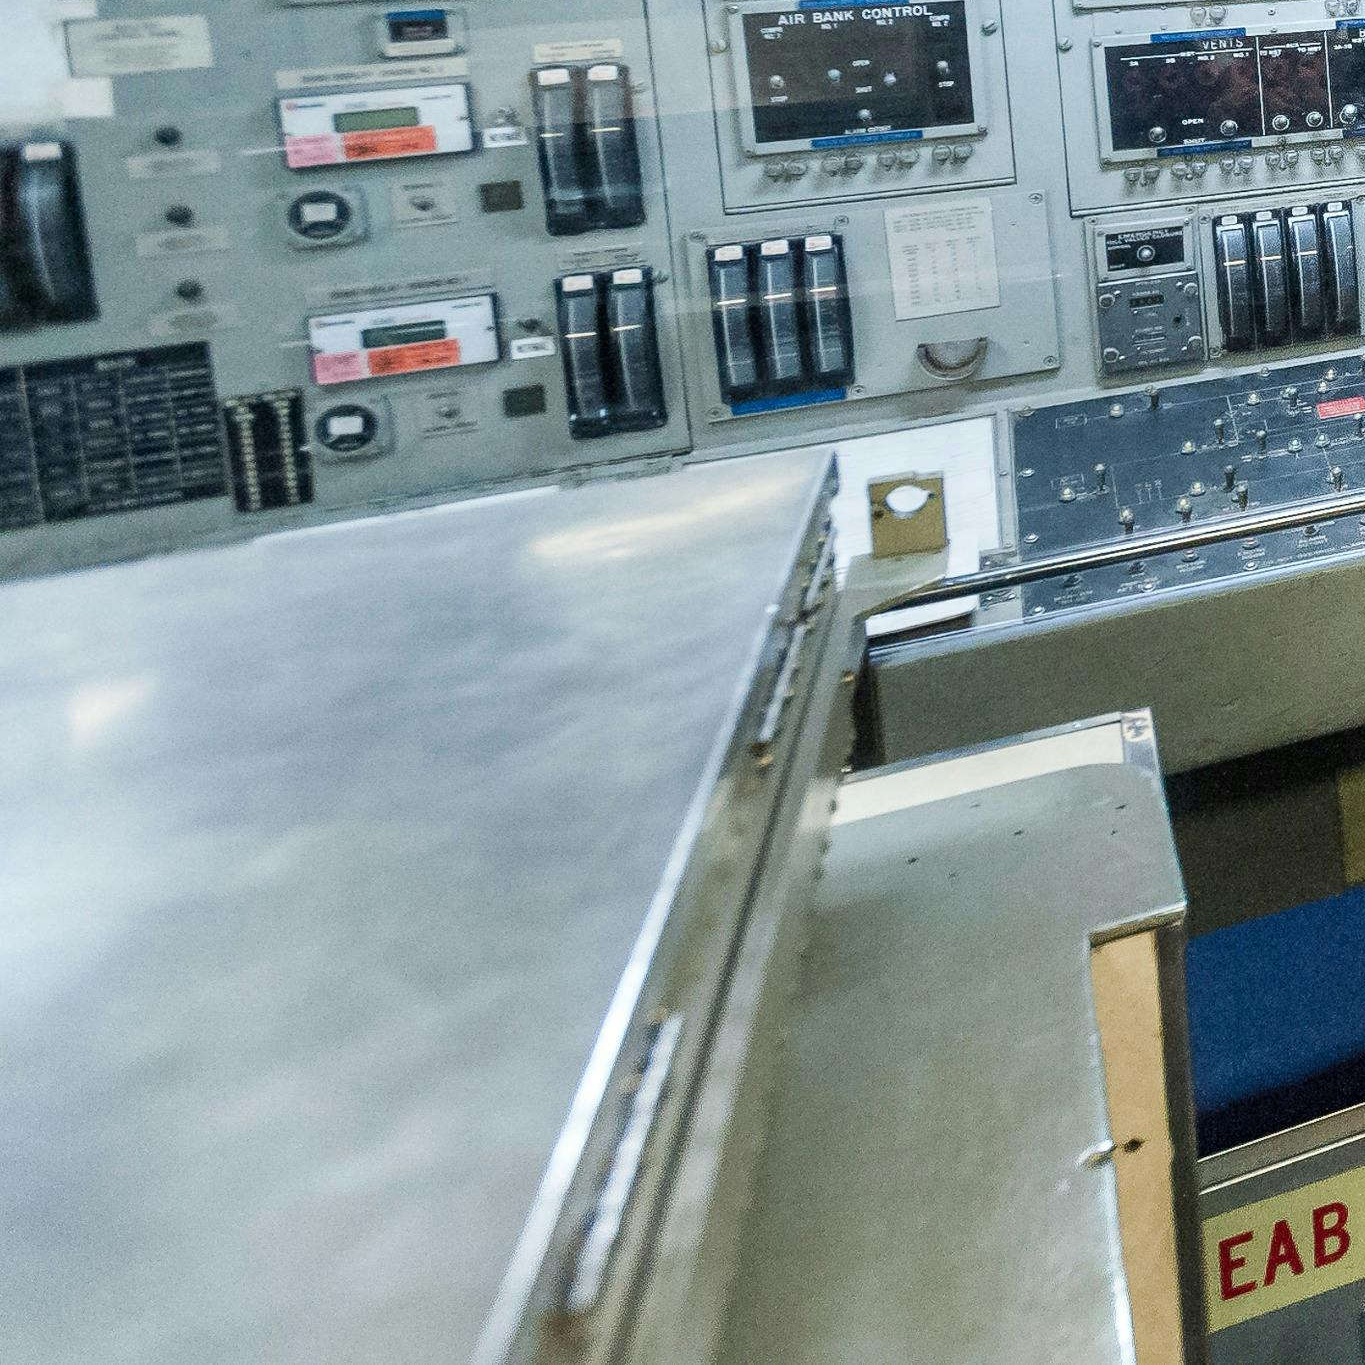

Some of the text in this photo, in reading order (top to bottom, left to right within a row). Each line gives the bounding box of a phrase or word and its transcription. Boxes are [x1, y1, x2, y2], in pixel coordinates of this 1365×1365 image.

[777, 5, 934, 26] AIR BANK CONTROL
[1202, 38, 1244, 51] VENTS
[1218, 1202, 1351, 1301] EAB
